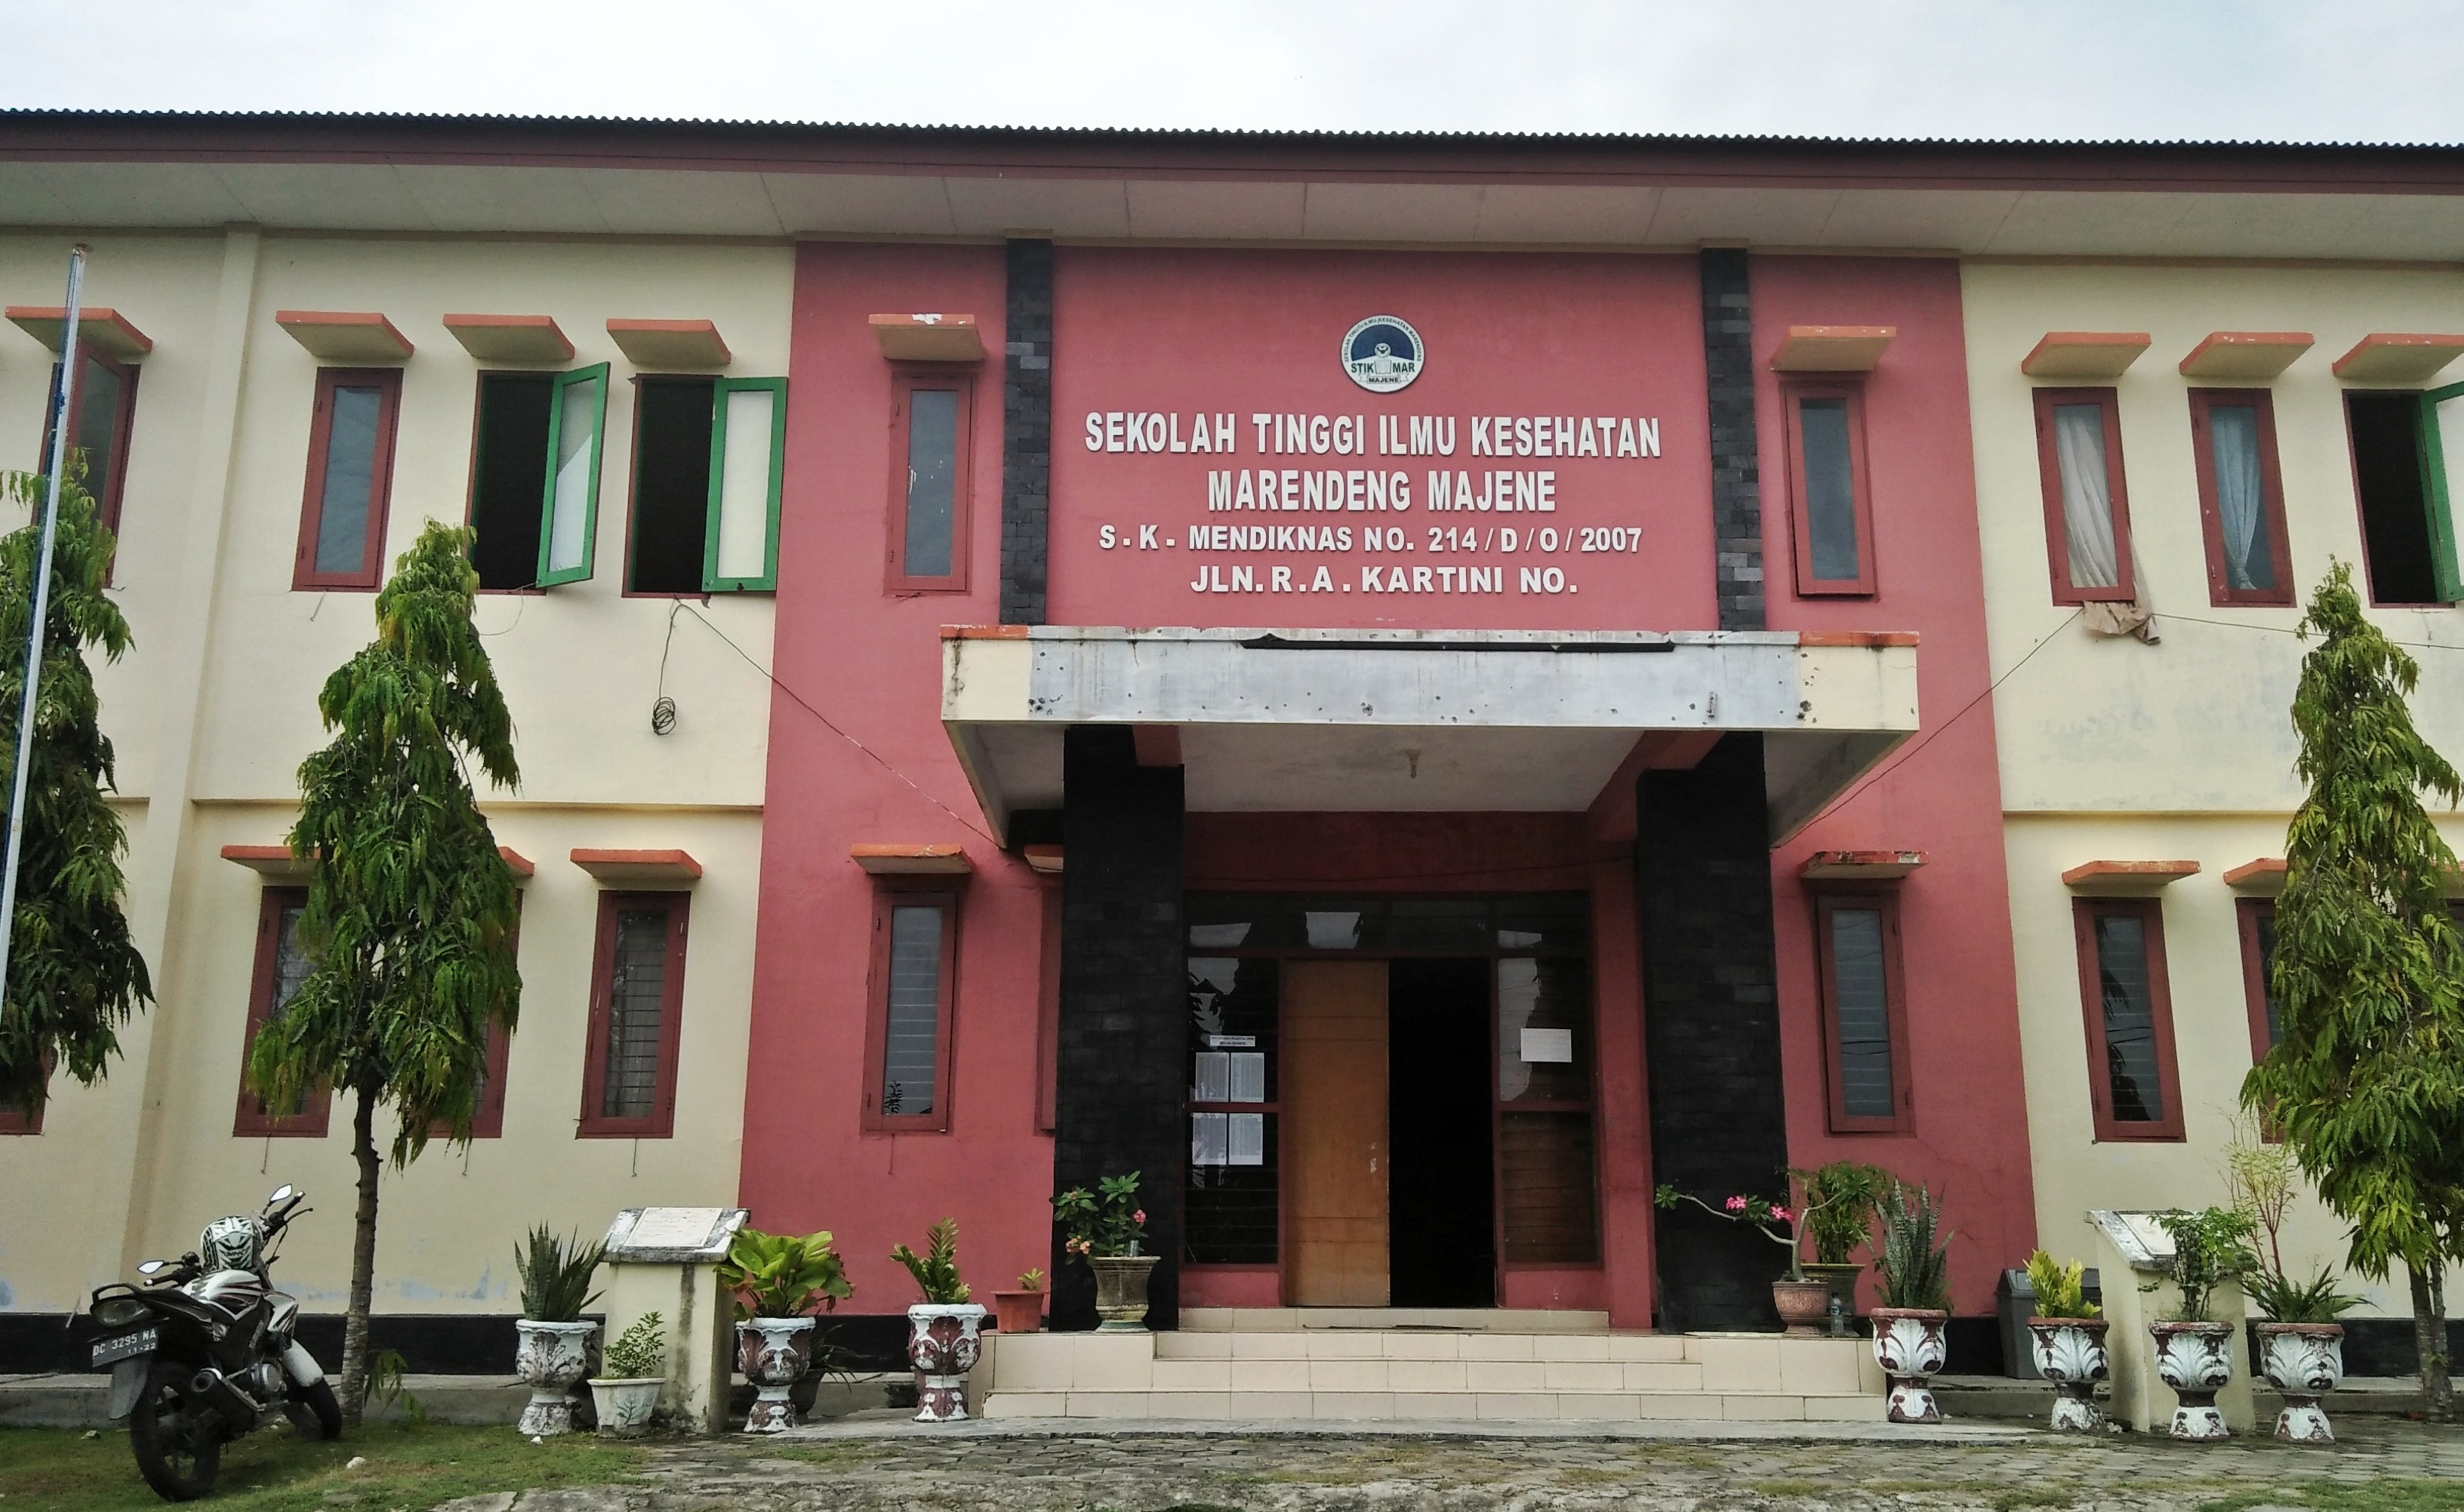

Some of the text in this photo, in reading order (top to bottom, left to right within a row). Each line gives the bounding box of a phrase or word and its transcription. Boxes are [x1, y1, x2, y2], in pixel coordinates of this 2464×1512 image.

[1378, 318, 1409, 331] KESEHATAN
[1351, 362, 1415, 373] STIK MAR
[1085, 411, 1662, 458] SEKOLAH TINGGI ILMU KESEHATAN
[1208, 469, 1557, 512] MARENDENG MAJENE
[1188, 525, 1353, 552] MENDIKNAS
[1363, 526, 1415, 553] NO.
[1519, 567, 1578, 594] NO.
[92, 1344, 106, 1356] DC
[112, 1333, 138, 1350] 3295
